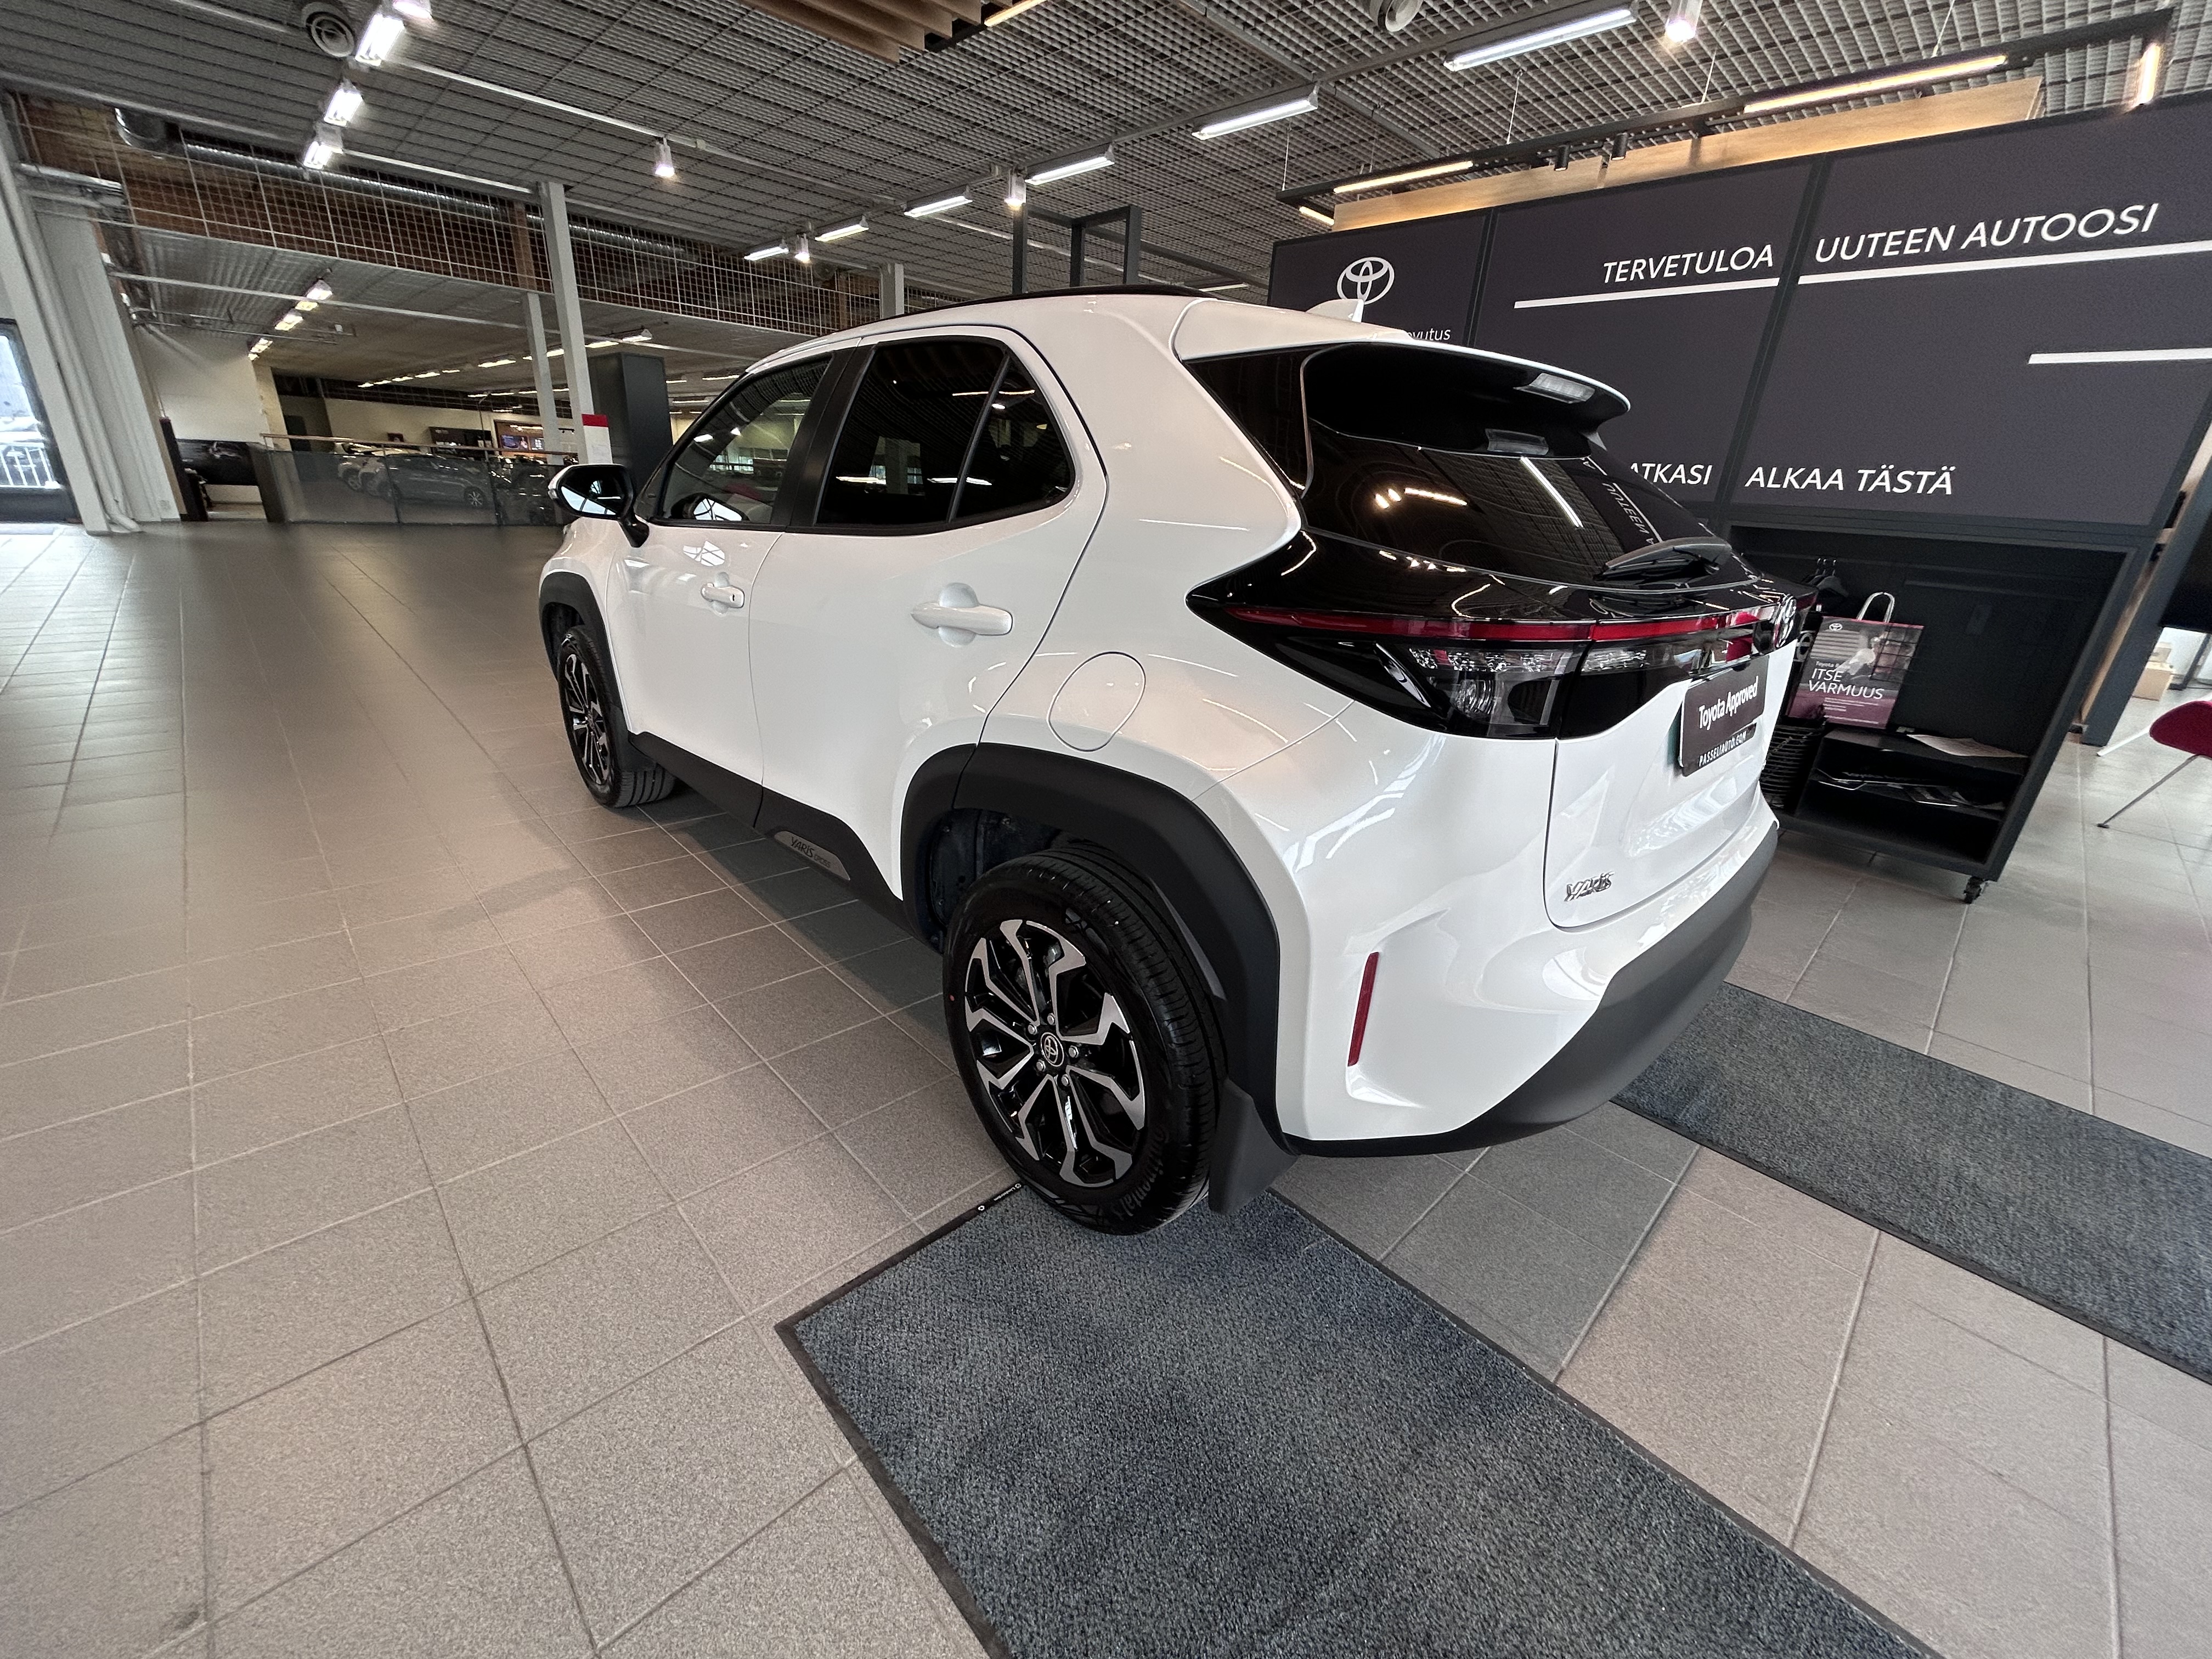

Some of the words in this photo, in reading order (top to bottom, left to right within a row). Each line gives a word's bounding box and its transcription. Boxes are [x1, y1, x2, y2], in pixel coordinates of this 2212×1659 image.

[1604, 245, 1773, 284] TERVETULOA
[1815, 225, 1956, 263] UUTEEN
[1960, 203, 2159, 250] AUTOOSI
[1745, 466, 1844, 492] ALKAA
[1857, 464, 1956, 495] TÄSTÄ
[1809, 680, 1884, 699] VARMUUS
[1812, 668, 1843, 682] ITSE
[1699, 698, 1725, 730] Toyota
[1725, 676, 1759, 716] Approved
